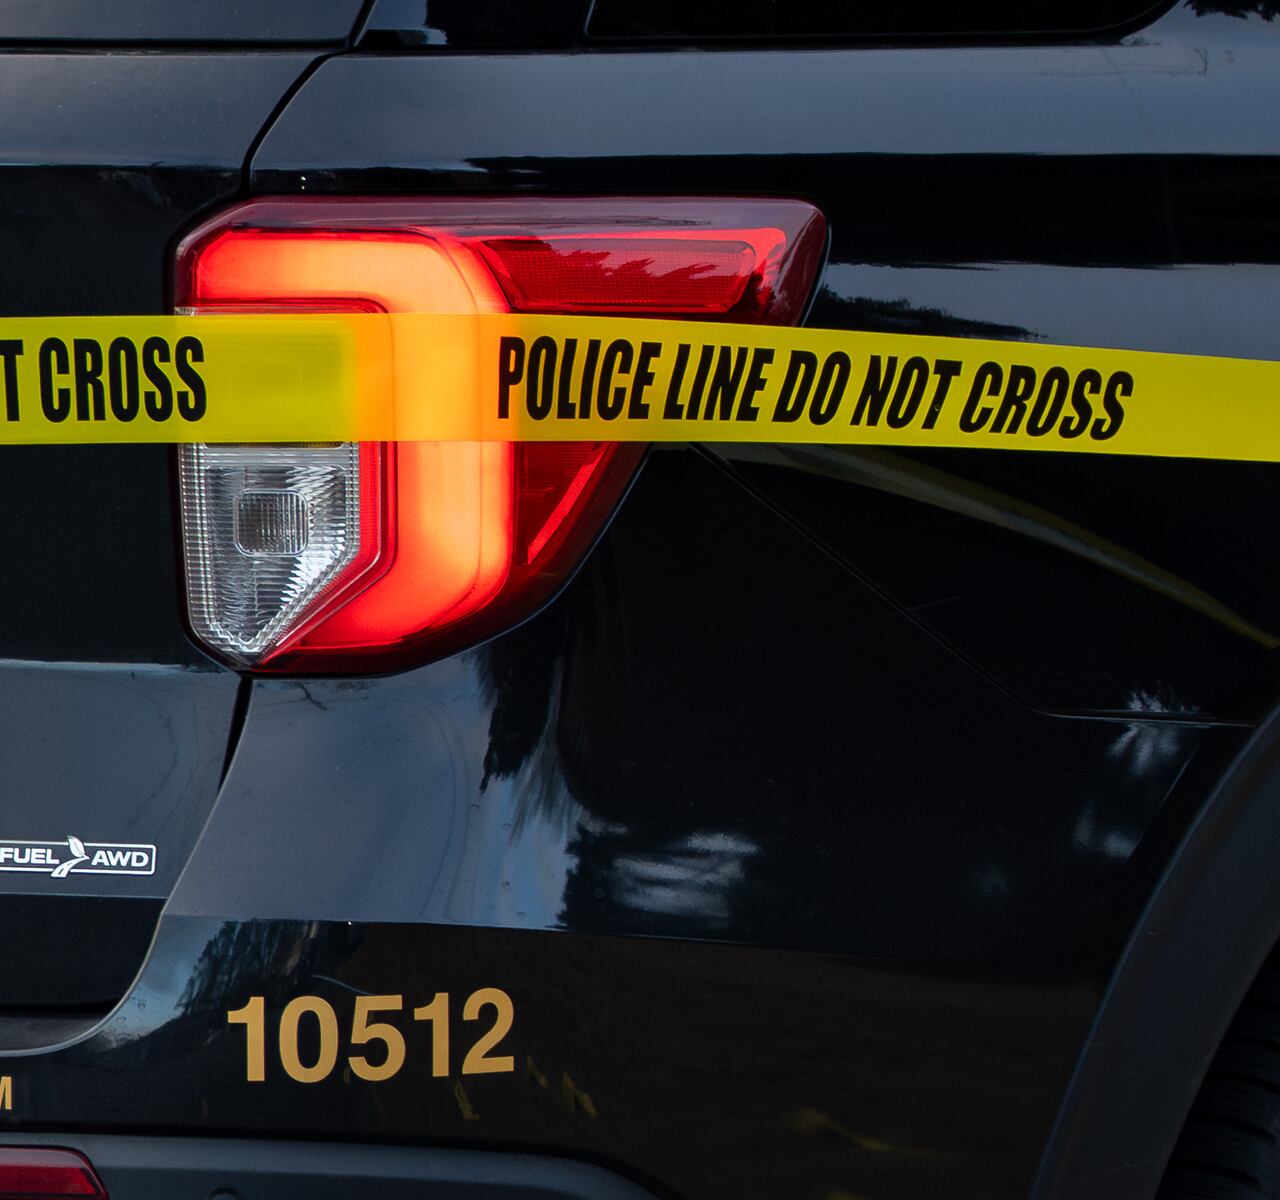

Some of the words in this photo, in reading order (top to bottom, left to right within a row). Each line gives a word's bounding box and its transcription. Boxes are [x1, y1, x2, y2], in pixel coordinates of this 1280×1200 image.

[38, 336, 207, 424] CROSS
[498, 335, 663, 421] POLICE
[662, 343, 775, 422] LINE
[771, 349, 852, 427] DO
[849, 354, 963, 431] NOT
[958, 361, 1134, 442] CROSS
[0, 847, 60, 865] FUEL
[91, 850, 149, 867] AWD
[227, 987, 514, 1083] 10512
